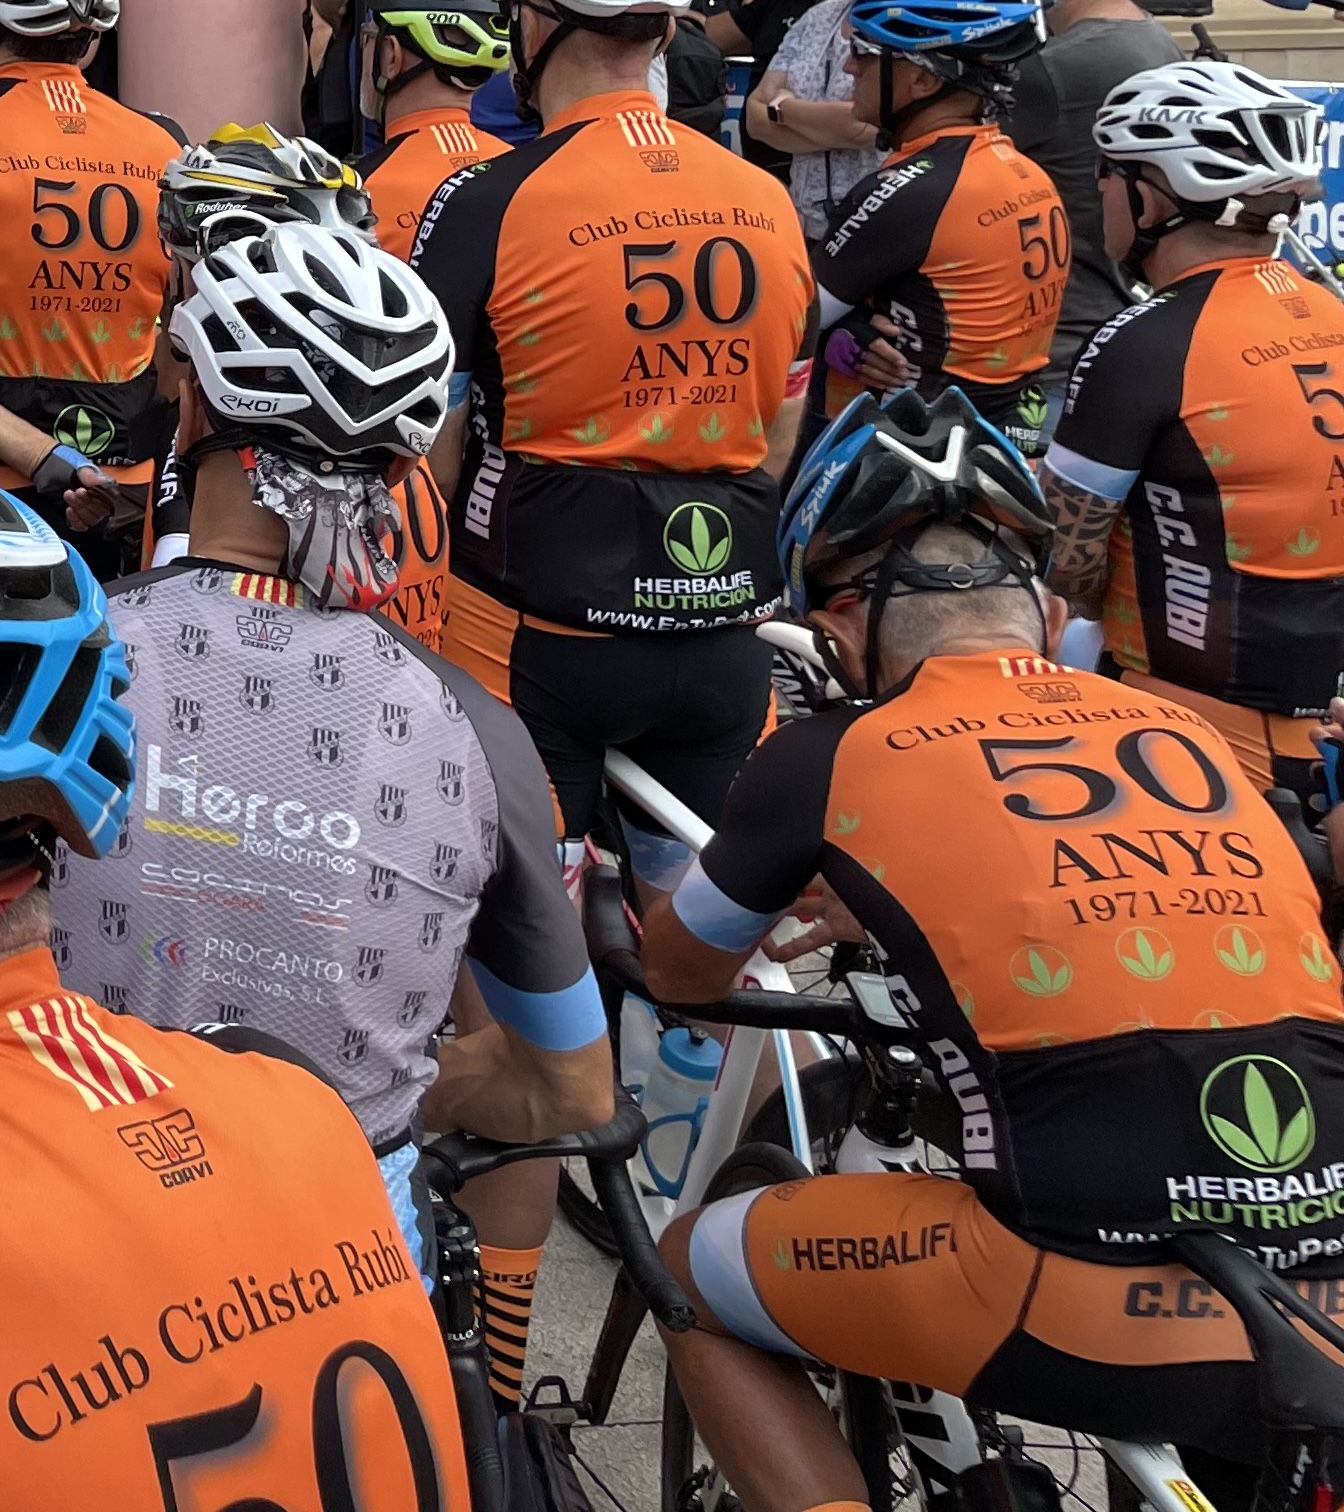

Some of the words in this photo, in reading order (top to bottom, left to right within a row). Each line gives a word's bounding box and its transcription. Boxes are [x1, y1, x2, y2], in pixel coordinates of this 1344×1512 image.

[1138, 106, 1209, 126] KASK
[45, 154, 116, 175] Ciclista
[123, 160, 167, 183] Rubí
[30, 176, 141, 253] 50
[568, 215, 629, 247] Club
[633, 209, 724, 231] Ciclista
[731, 207, 777, 234] Rubí
[824, 163, 925, 259] HERBALIFE
[977, 201, 1019, 228] Club
[1017, 205, 1071, 282] 50
[27, 259, 134, 292] ANYS
[621, 236, 759, 332] 50
[29, 296, 122, 314] 1971-2021
[621, 338, 750, 382] ANYS
[1240, 342, 1290, 368] Club
[622, 385, 738, 409] 1971-2021
[1144, 481, 1198, 549] C.C.
[633, 570, 753, 596] HERBALIFE
[1162, 553, 1212, 650] RUBI
[884, 718, 987, 752] Club
[997, 705, 1147, 729] Ciclista
[978, 727, 1229, 822] 50
[1047, 829, 1266, 889] ANYS
[1065, 888, 1269, 926] 1971-2021
[204, 937, 343, 983] PROCANTO
[1166, 1161, 1344, 1202] HERBALIF
[1123, 1281, 1228, 1319] C.C.
[7, 1336, 152, 1444] Club
[157, 1262, 341, 1365] Ciclista
[333, 1227, 413, 1303] Rubí
